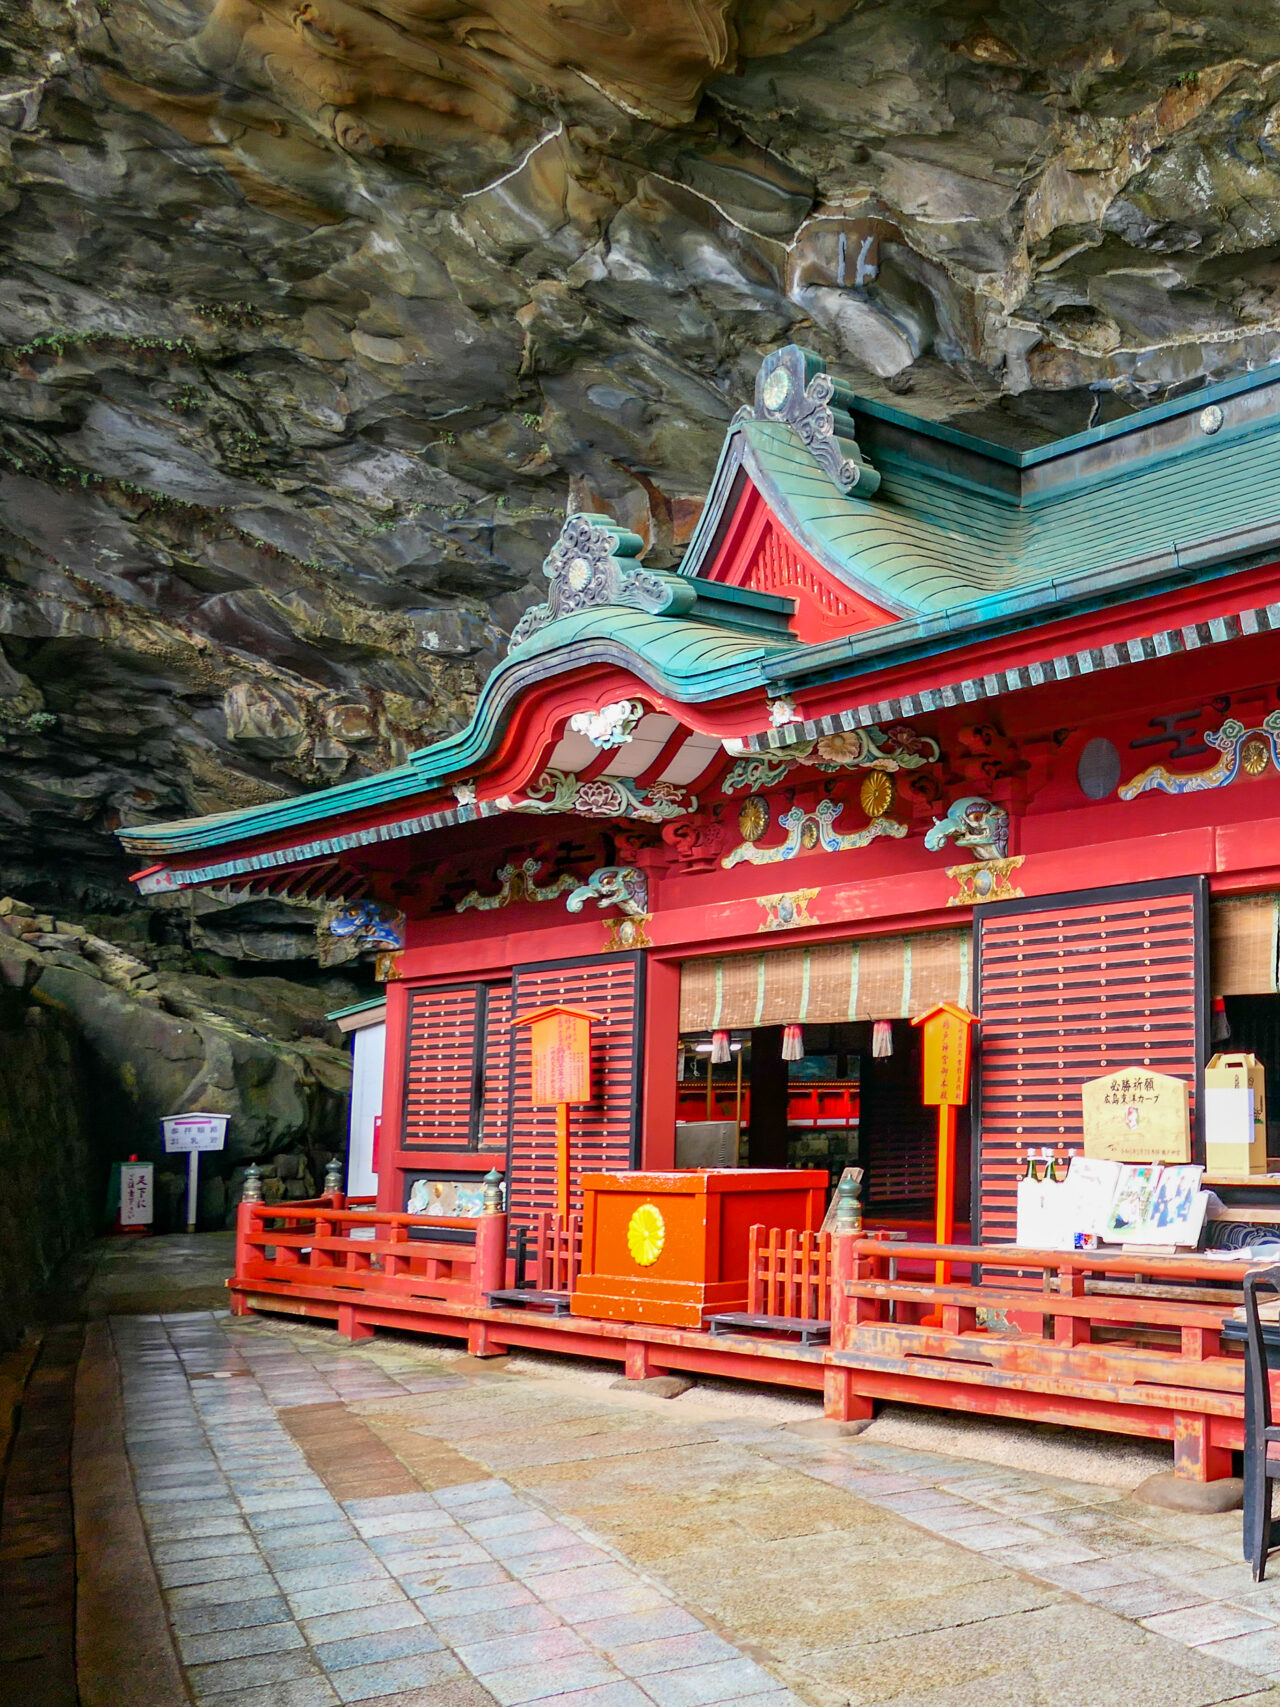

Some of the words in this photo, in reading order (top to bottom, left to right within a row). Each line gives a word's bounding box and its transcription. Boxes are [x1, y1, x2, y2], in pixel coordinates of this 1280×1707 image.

[1110, 1077, 1155, 1092] 必勝祈願
[1103, 1093, 1160, 1105] 広島東洋カープ
